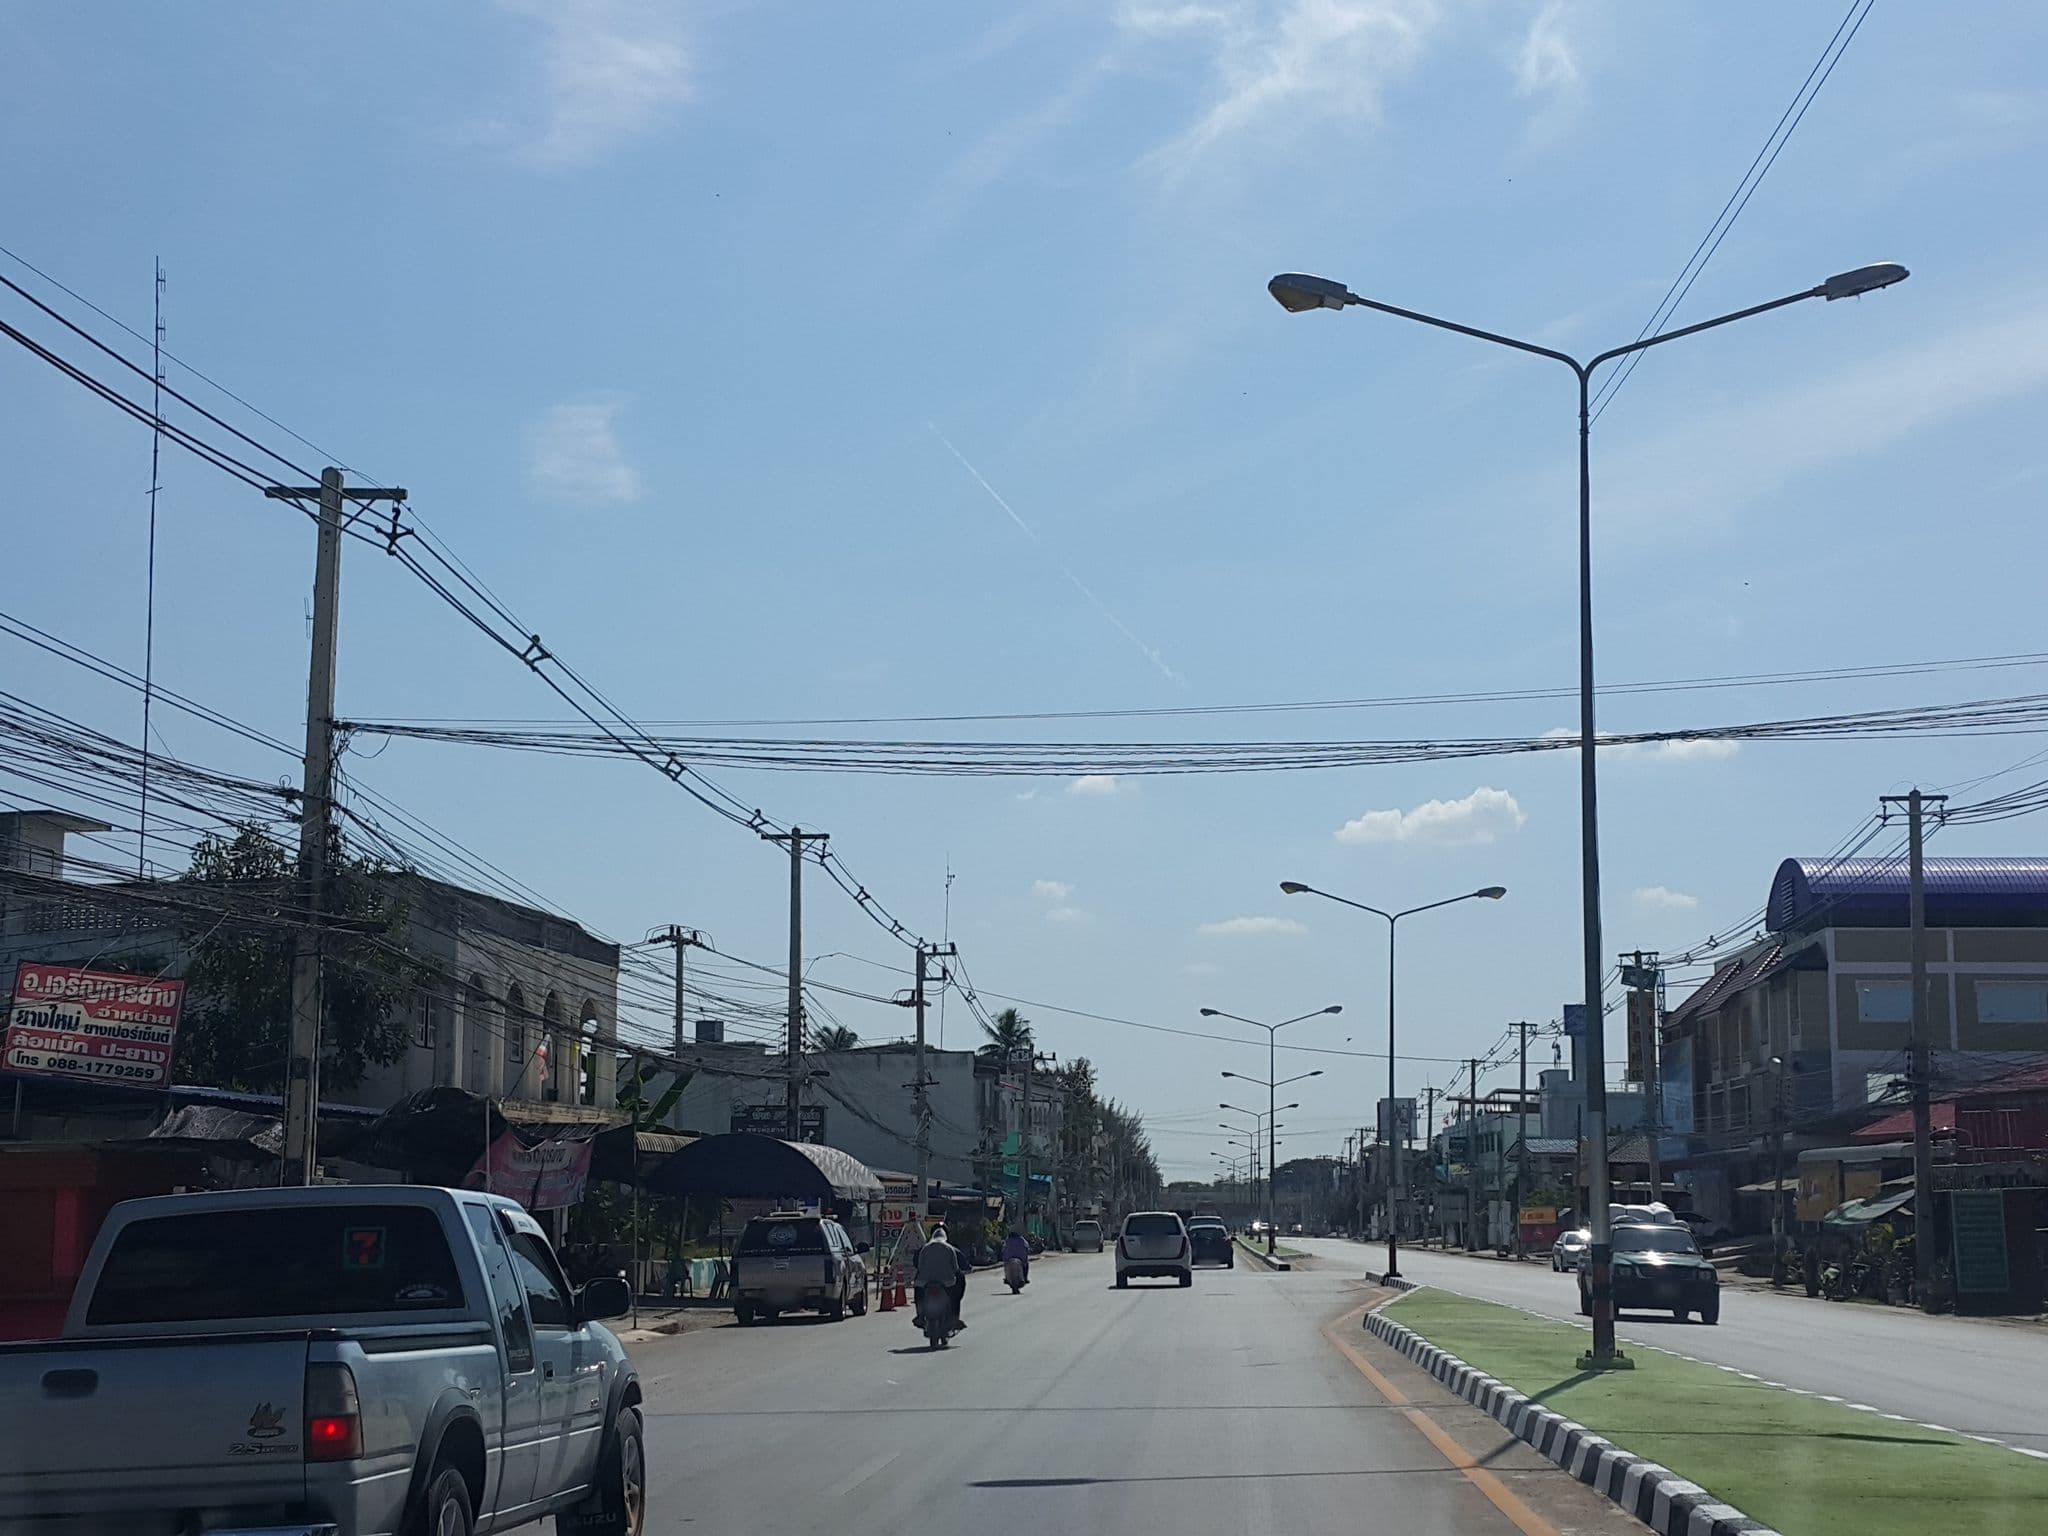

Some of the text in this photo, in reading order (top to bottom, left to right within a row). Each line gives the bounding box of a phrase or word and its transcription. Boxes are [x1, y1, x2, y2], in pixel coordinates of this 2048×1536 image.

[16, 1005, 171, 1043] ยางใหม่ ยางเปอร์เซ็นต์
[96, 1005, 172, 1025] จำหน่าย
[16, 1051, 155, 1079] โทร 088-1779259
[100, 1043, 166, 1063] ปะยาง
